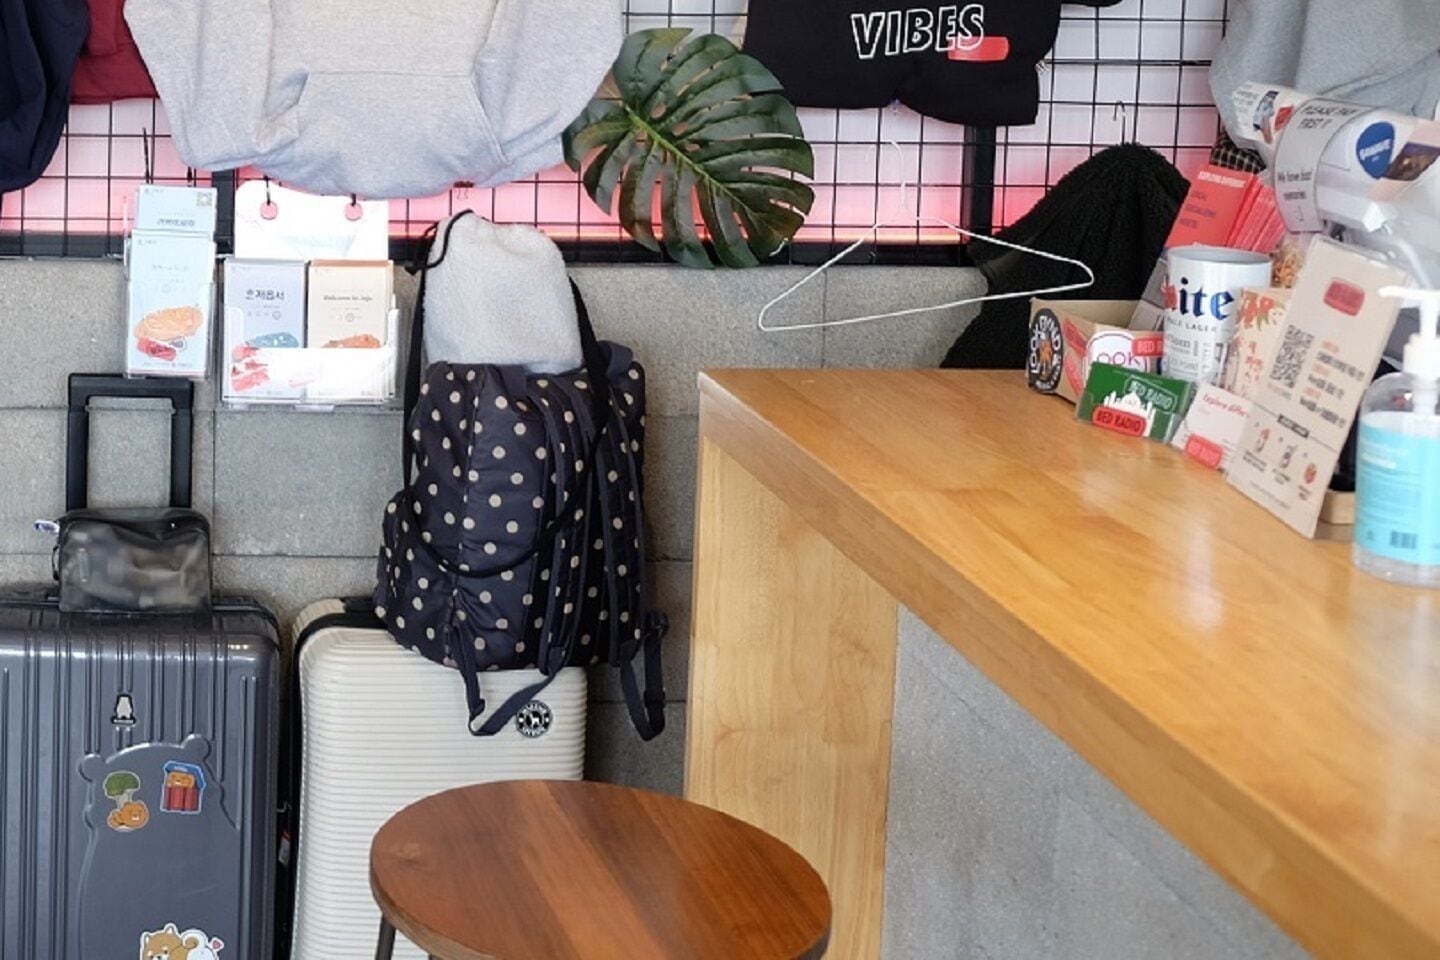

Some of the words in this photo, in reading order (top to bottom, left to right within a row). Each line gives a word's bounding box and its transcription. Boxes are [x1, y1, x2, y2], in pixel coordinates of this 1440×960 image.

[851, 3, 985, 59] VIBES
[1129, 380, 1146, 396] BED
[1145, 388, 1174, 410] RADIO
[1096, 410, 1114, 425] BED
[1114, 415, 1142, 432] RADIO
